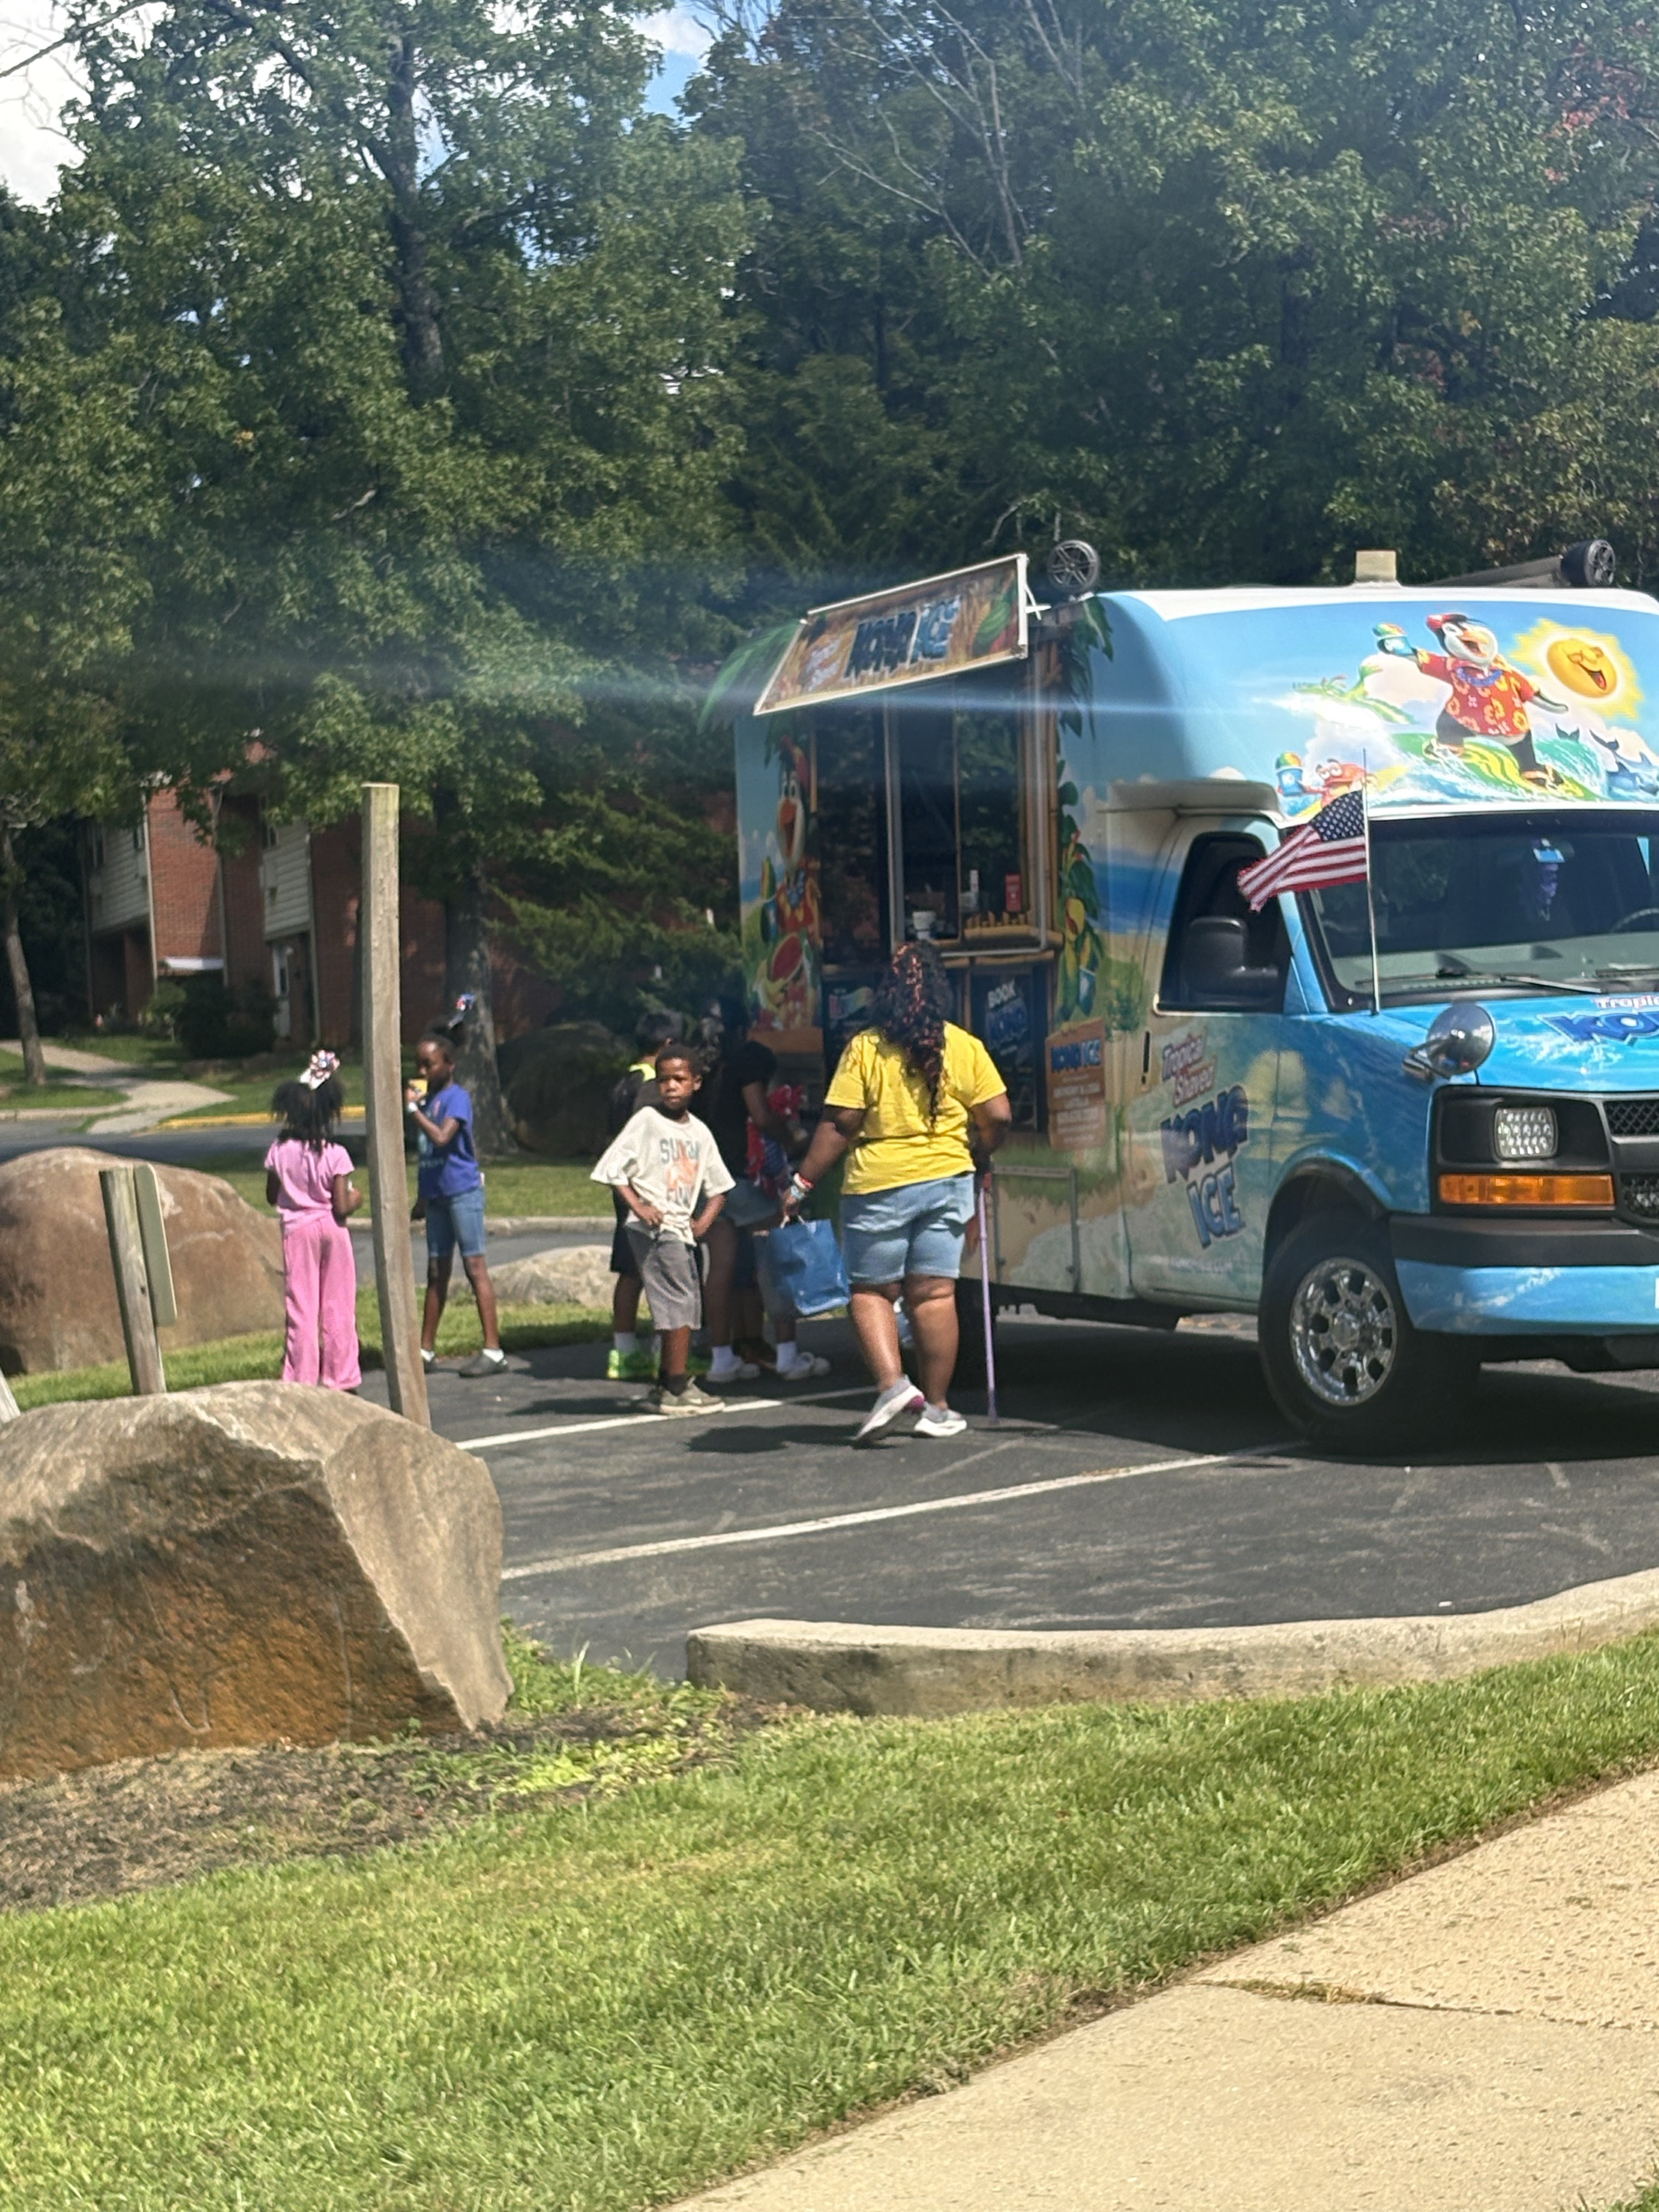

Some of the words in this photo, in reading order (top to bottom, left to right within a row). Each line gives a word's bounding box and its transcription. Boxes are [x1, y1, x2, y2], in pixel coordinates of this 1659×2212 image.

[1162, 1027, 1208, 1082] Tropical
[1173, 1053, 1217, 1109] Shaved
[1160, 1085, 1248, 1184] KONA
[1186, 1161, 1241, 1249] ICE
